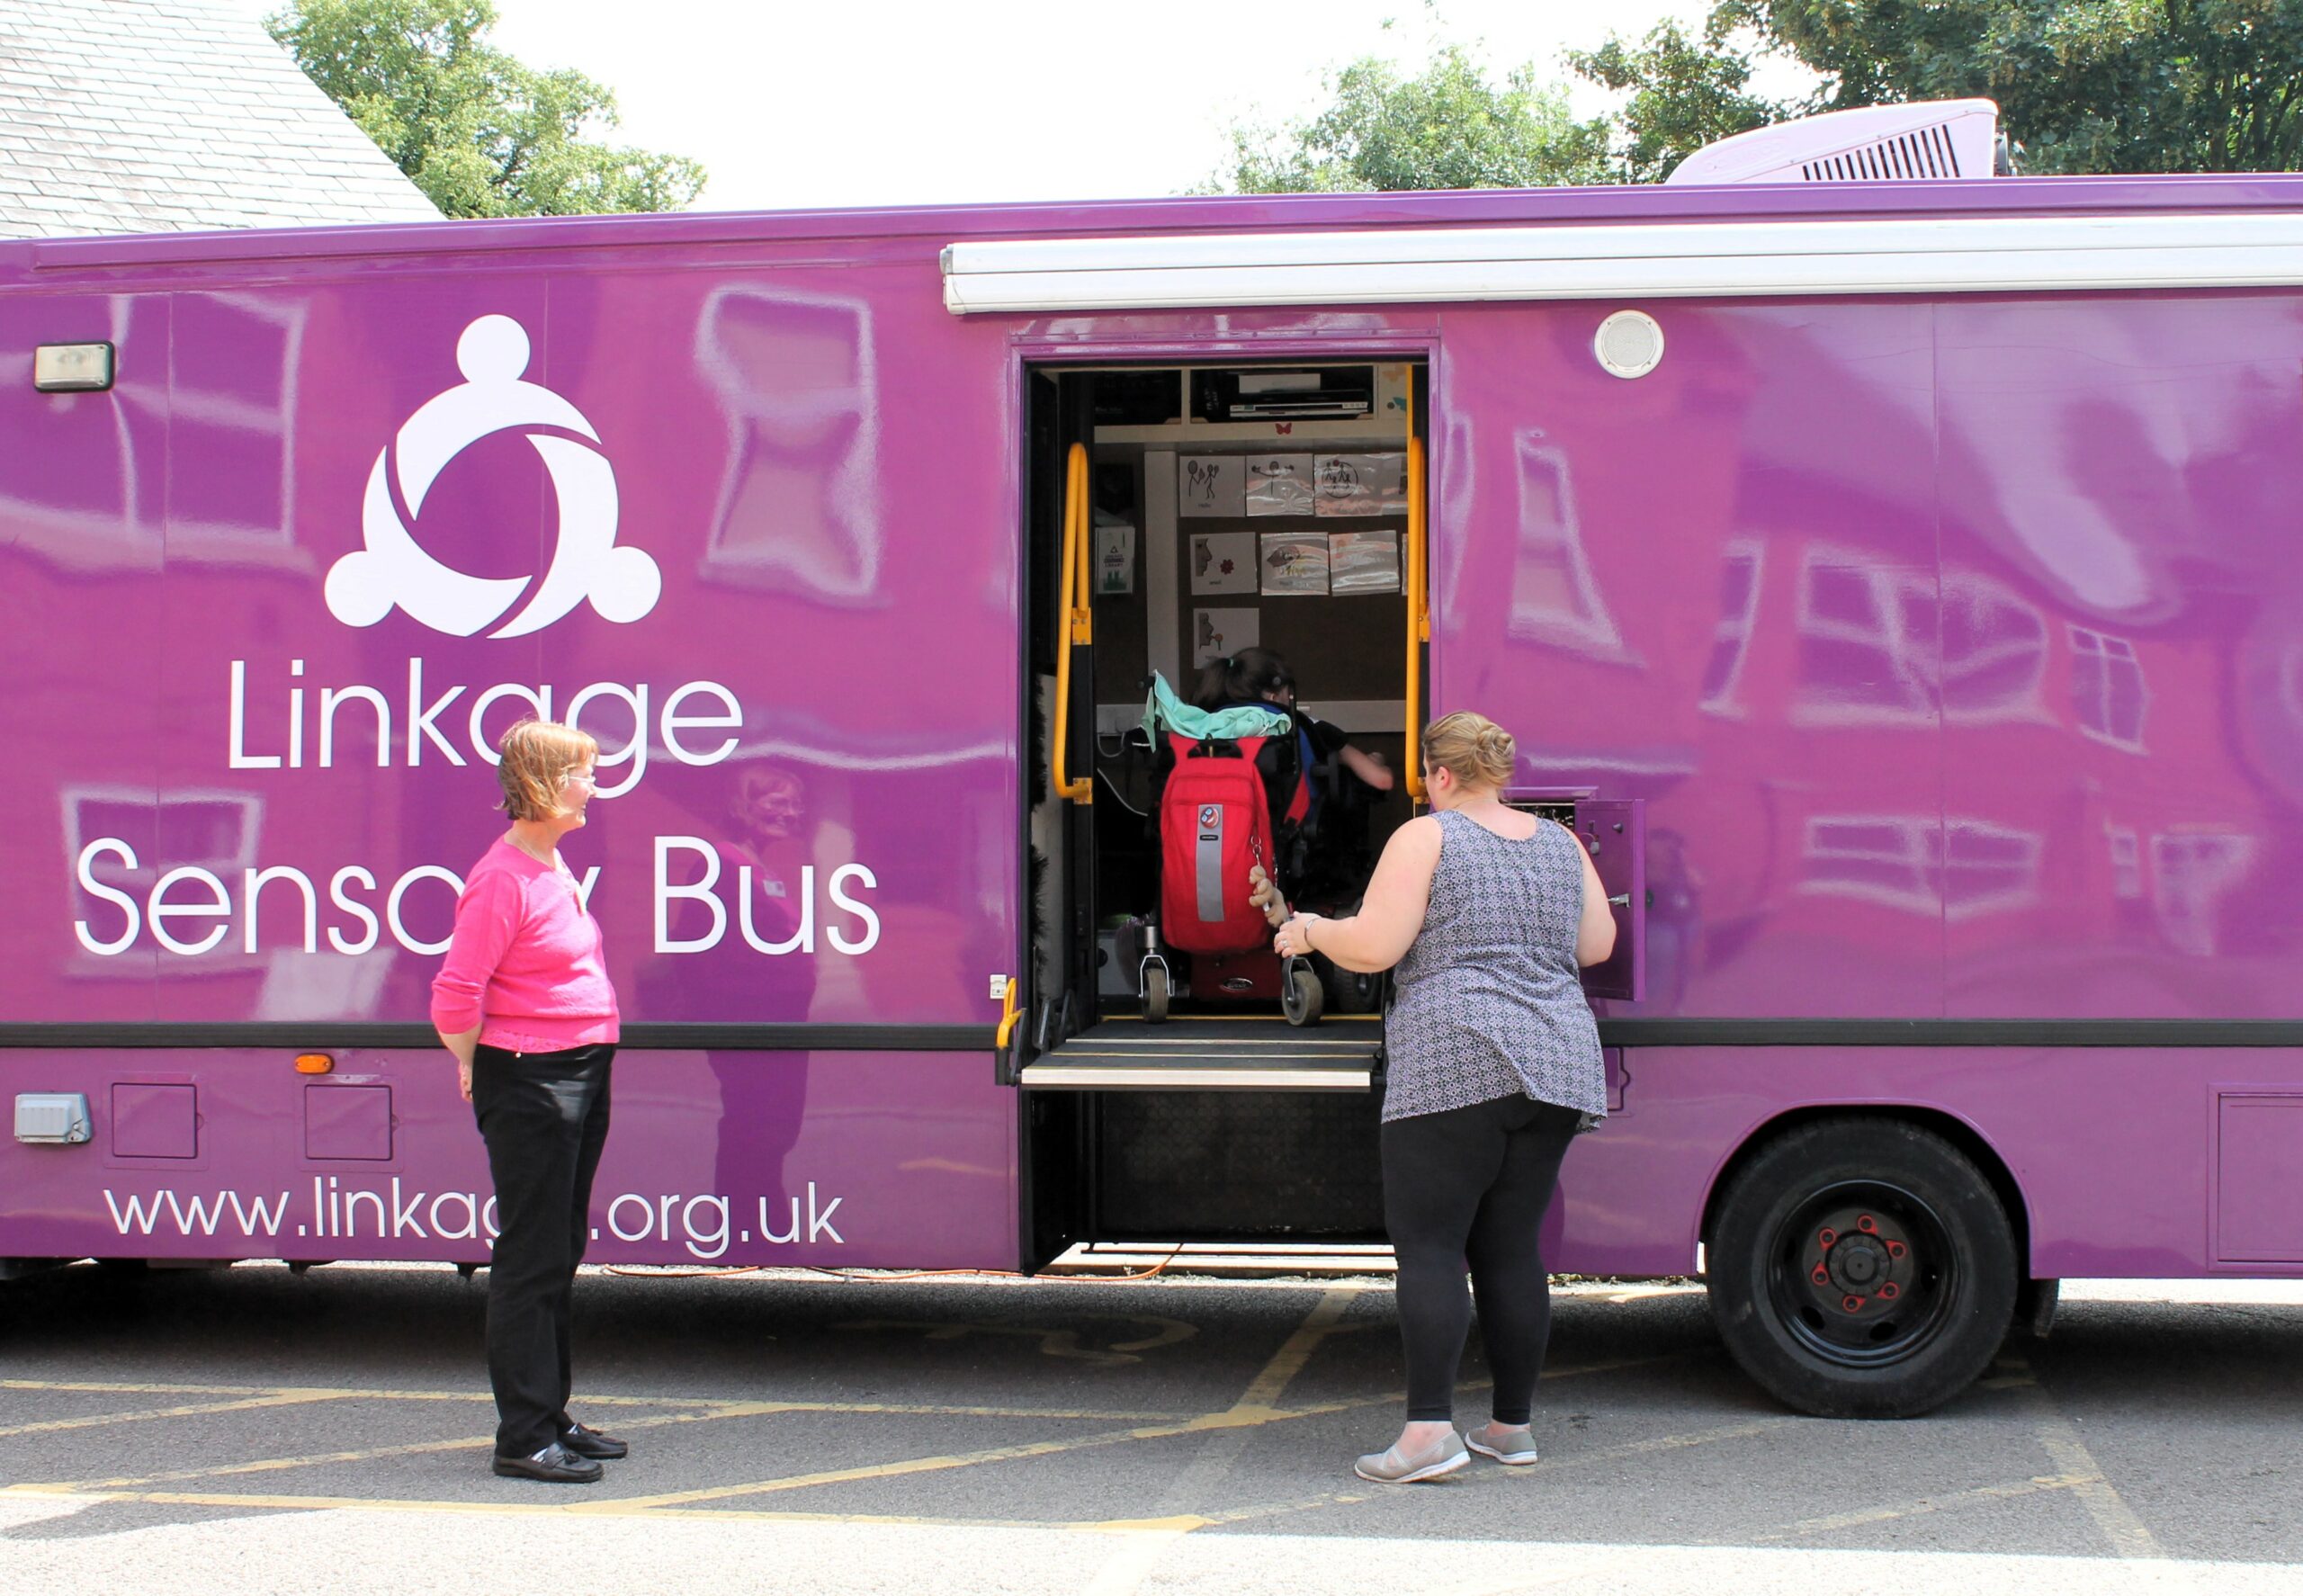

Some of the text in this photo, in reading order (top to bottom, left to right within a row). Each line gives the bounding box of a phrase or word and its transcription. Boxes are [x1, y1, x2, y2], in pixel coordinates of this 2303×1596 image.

[229, 657, 743, 799] Linkage
[75, 836, 881, 956] Senso Bus
[103, 1176, 845, 1259] www.linka.org.uk
